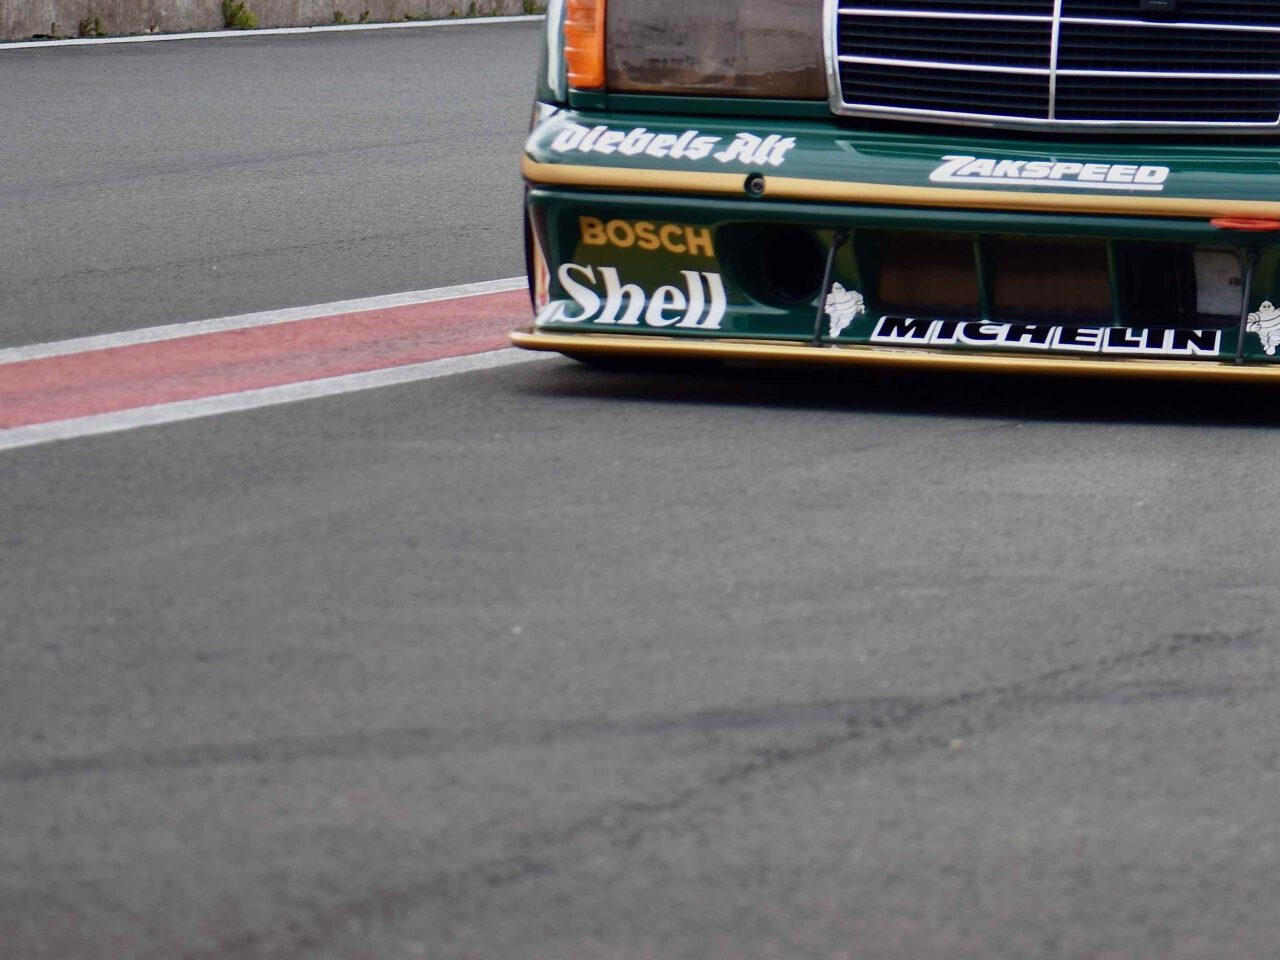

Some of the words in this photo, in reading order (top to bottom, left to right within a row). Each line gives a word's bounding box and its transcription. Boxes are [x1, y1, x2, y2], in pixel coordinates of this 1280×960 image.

[551, 121, 722, 161] Diebels
[713, 132, 796, 167] Alt
[928, 155, 1170, 191] ZAKSPEED
[579, 215, 715, 257] BOSCH
[551, 262, 728, 330] Shell
[870, 315, 1222, 357] MICHELIN
